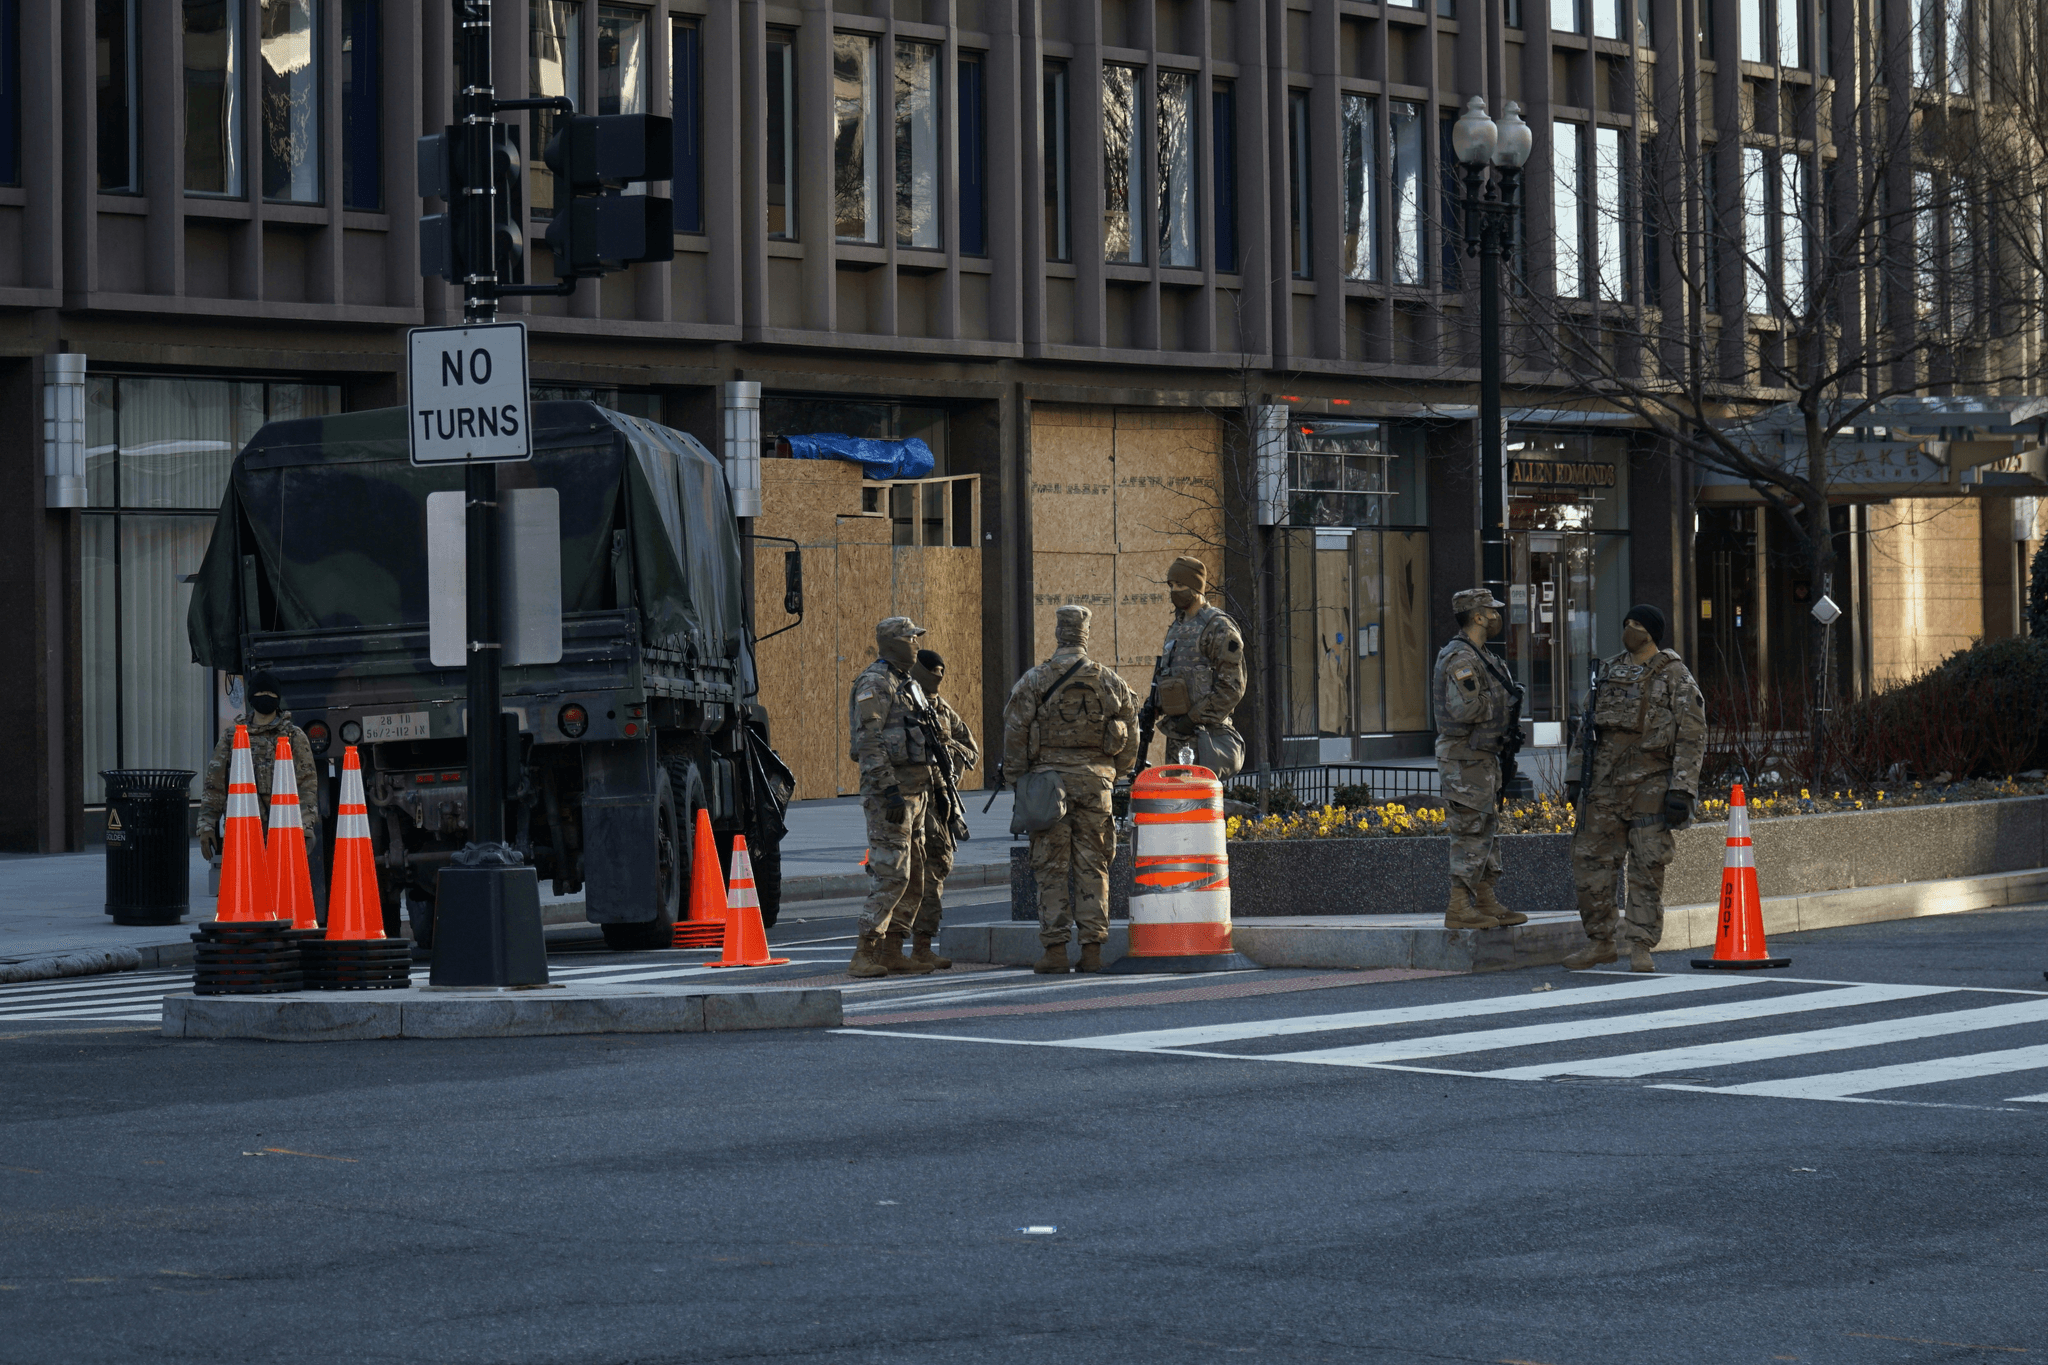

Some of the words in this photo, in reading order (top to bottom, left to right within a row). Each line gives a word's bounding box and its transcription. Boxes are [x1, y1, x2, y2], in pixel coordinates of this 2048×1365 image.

[442, 348, 492, 387] NO
[419, 405, 519, 440] TURNS
[1807, 449, 1919, 467] LAKE
[1512, 461, 1553, 483] ALLEN
[1555, 464, 1615, 485] EDMONDS
[1511, 590, 1526, 598] OPEN
[381, 716, 392, 726] 28
[401, 714, 411, 724] ID
[366, 727, 409, 739] 56/2-112
[1723, 883, 1733, 938] DDOT
